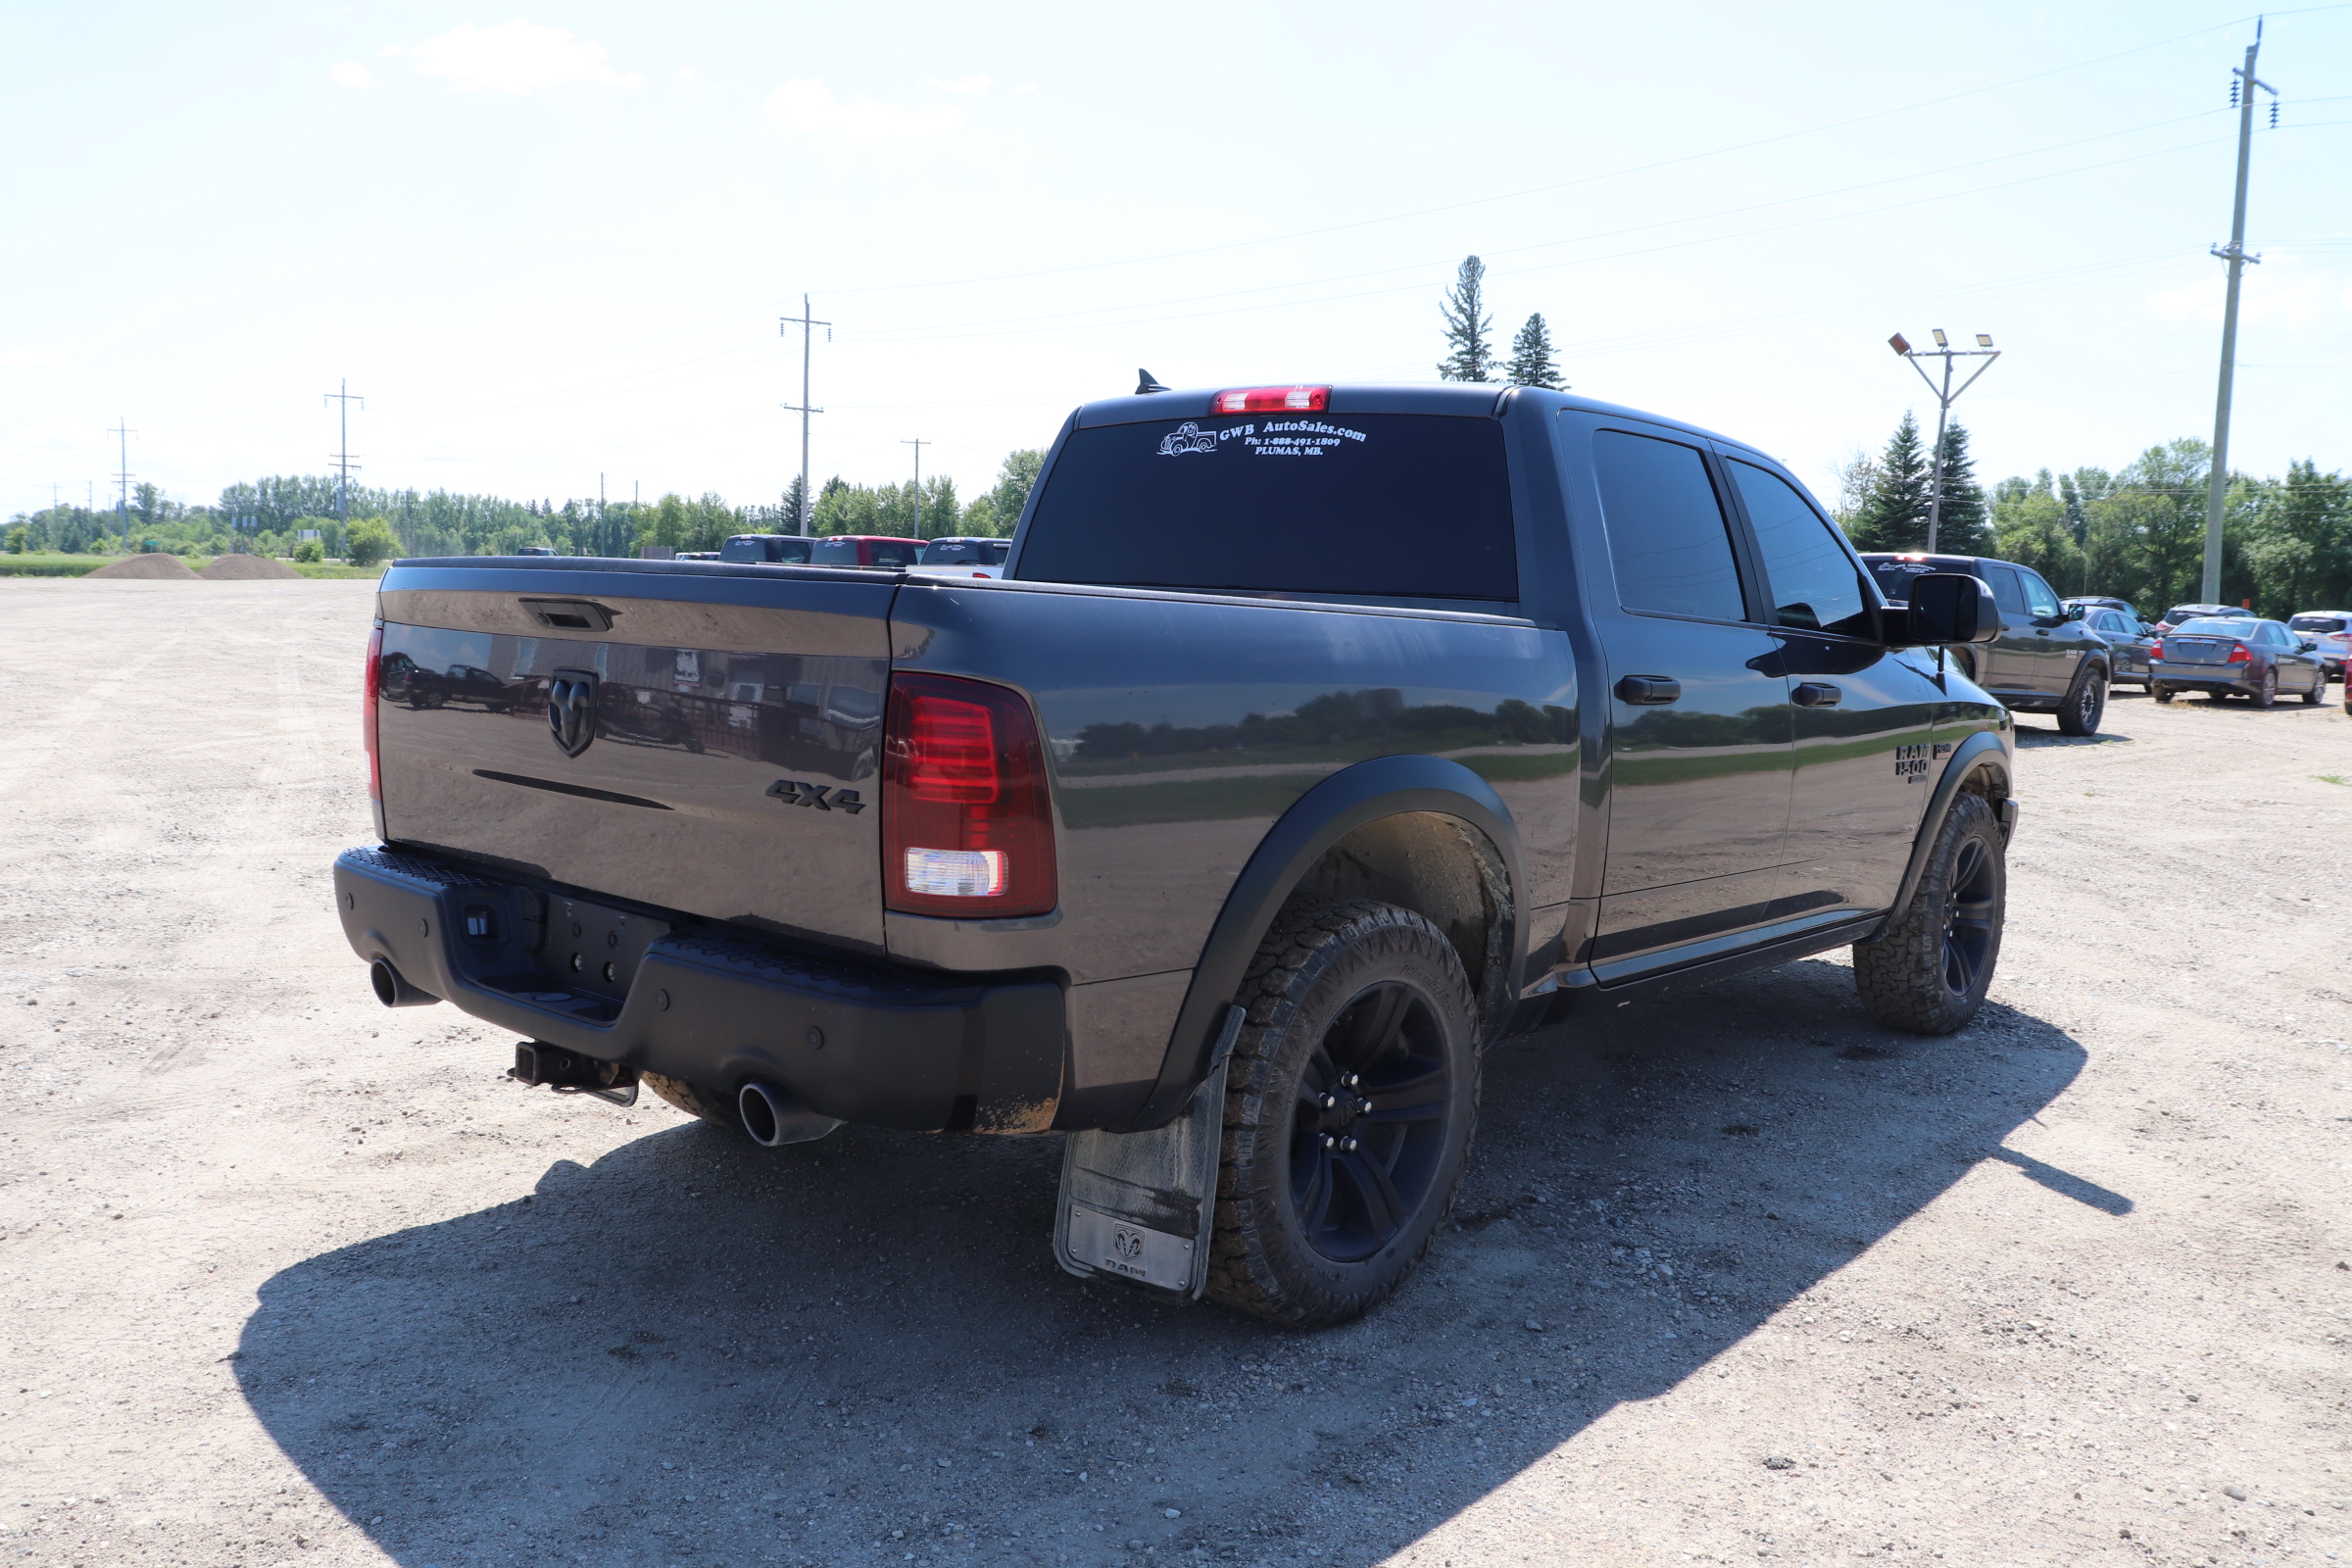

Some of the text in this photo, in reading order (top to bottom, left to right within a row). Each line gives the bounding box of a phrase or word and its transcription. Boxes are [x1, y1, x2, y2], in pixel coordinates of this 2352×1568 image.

[1219, 419, 1367, 442] GWB AutoSales.com
[1244, 436, 1261, 446] Ph:
[1254, 446, 1324, 457] PLUMAS, MB.
[1896, 744, 1931, 760] RAM
[1895, 760, 1929, 776] 1500
